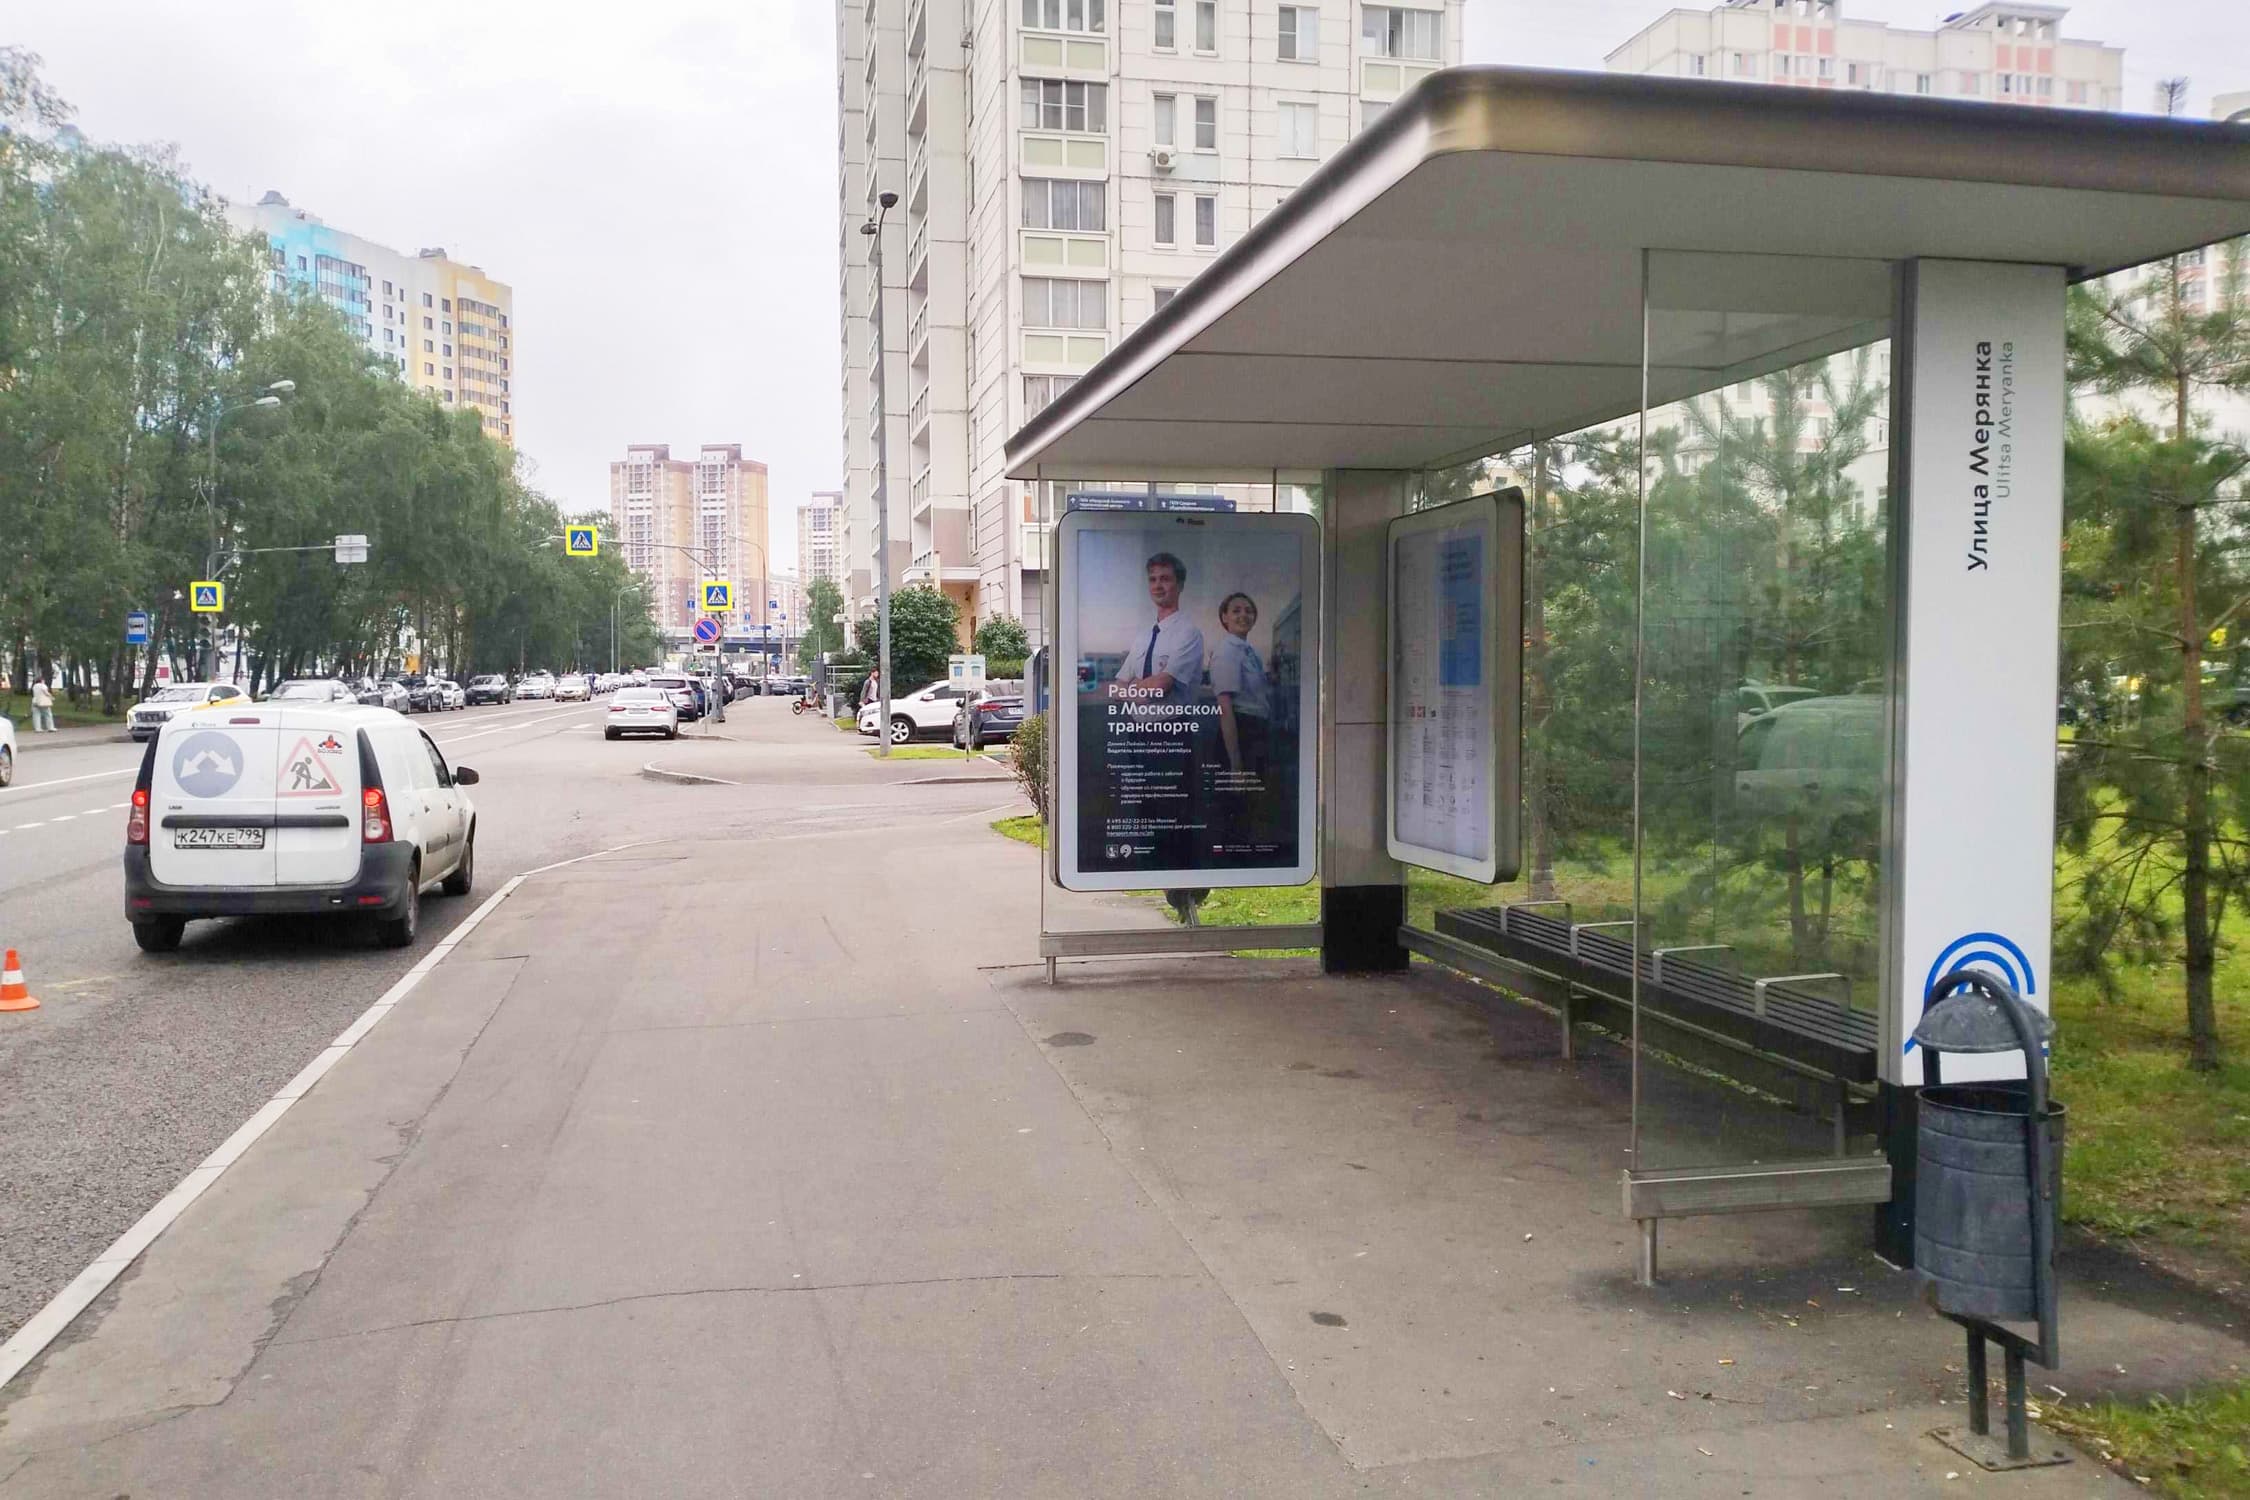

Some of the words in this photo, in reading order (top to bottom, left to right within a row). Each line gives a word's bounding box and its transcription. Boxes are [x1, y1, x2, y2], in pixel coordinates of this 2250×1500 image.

[1968, 341, 1995, 476] Мерянка
[1997, 341, 2016, 438] Meryanka
[1996, 443, 2012, 498] Ulitsa
[1967, 484, 1992, 571] Улица
[1107, 704, 1117, 715] в
[1120, 701, 1223, 715] Московском
[1108, 684, 1164, 698] Работа
[1107, 721, 1199, 736] транспорте
